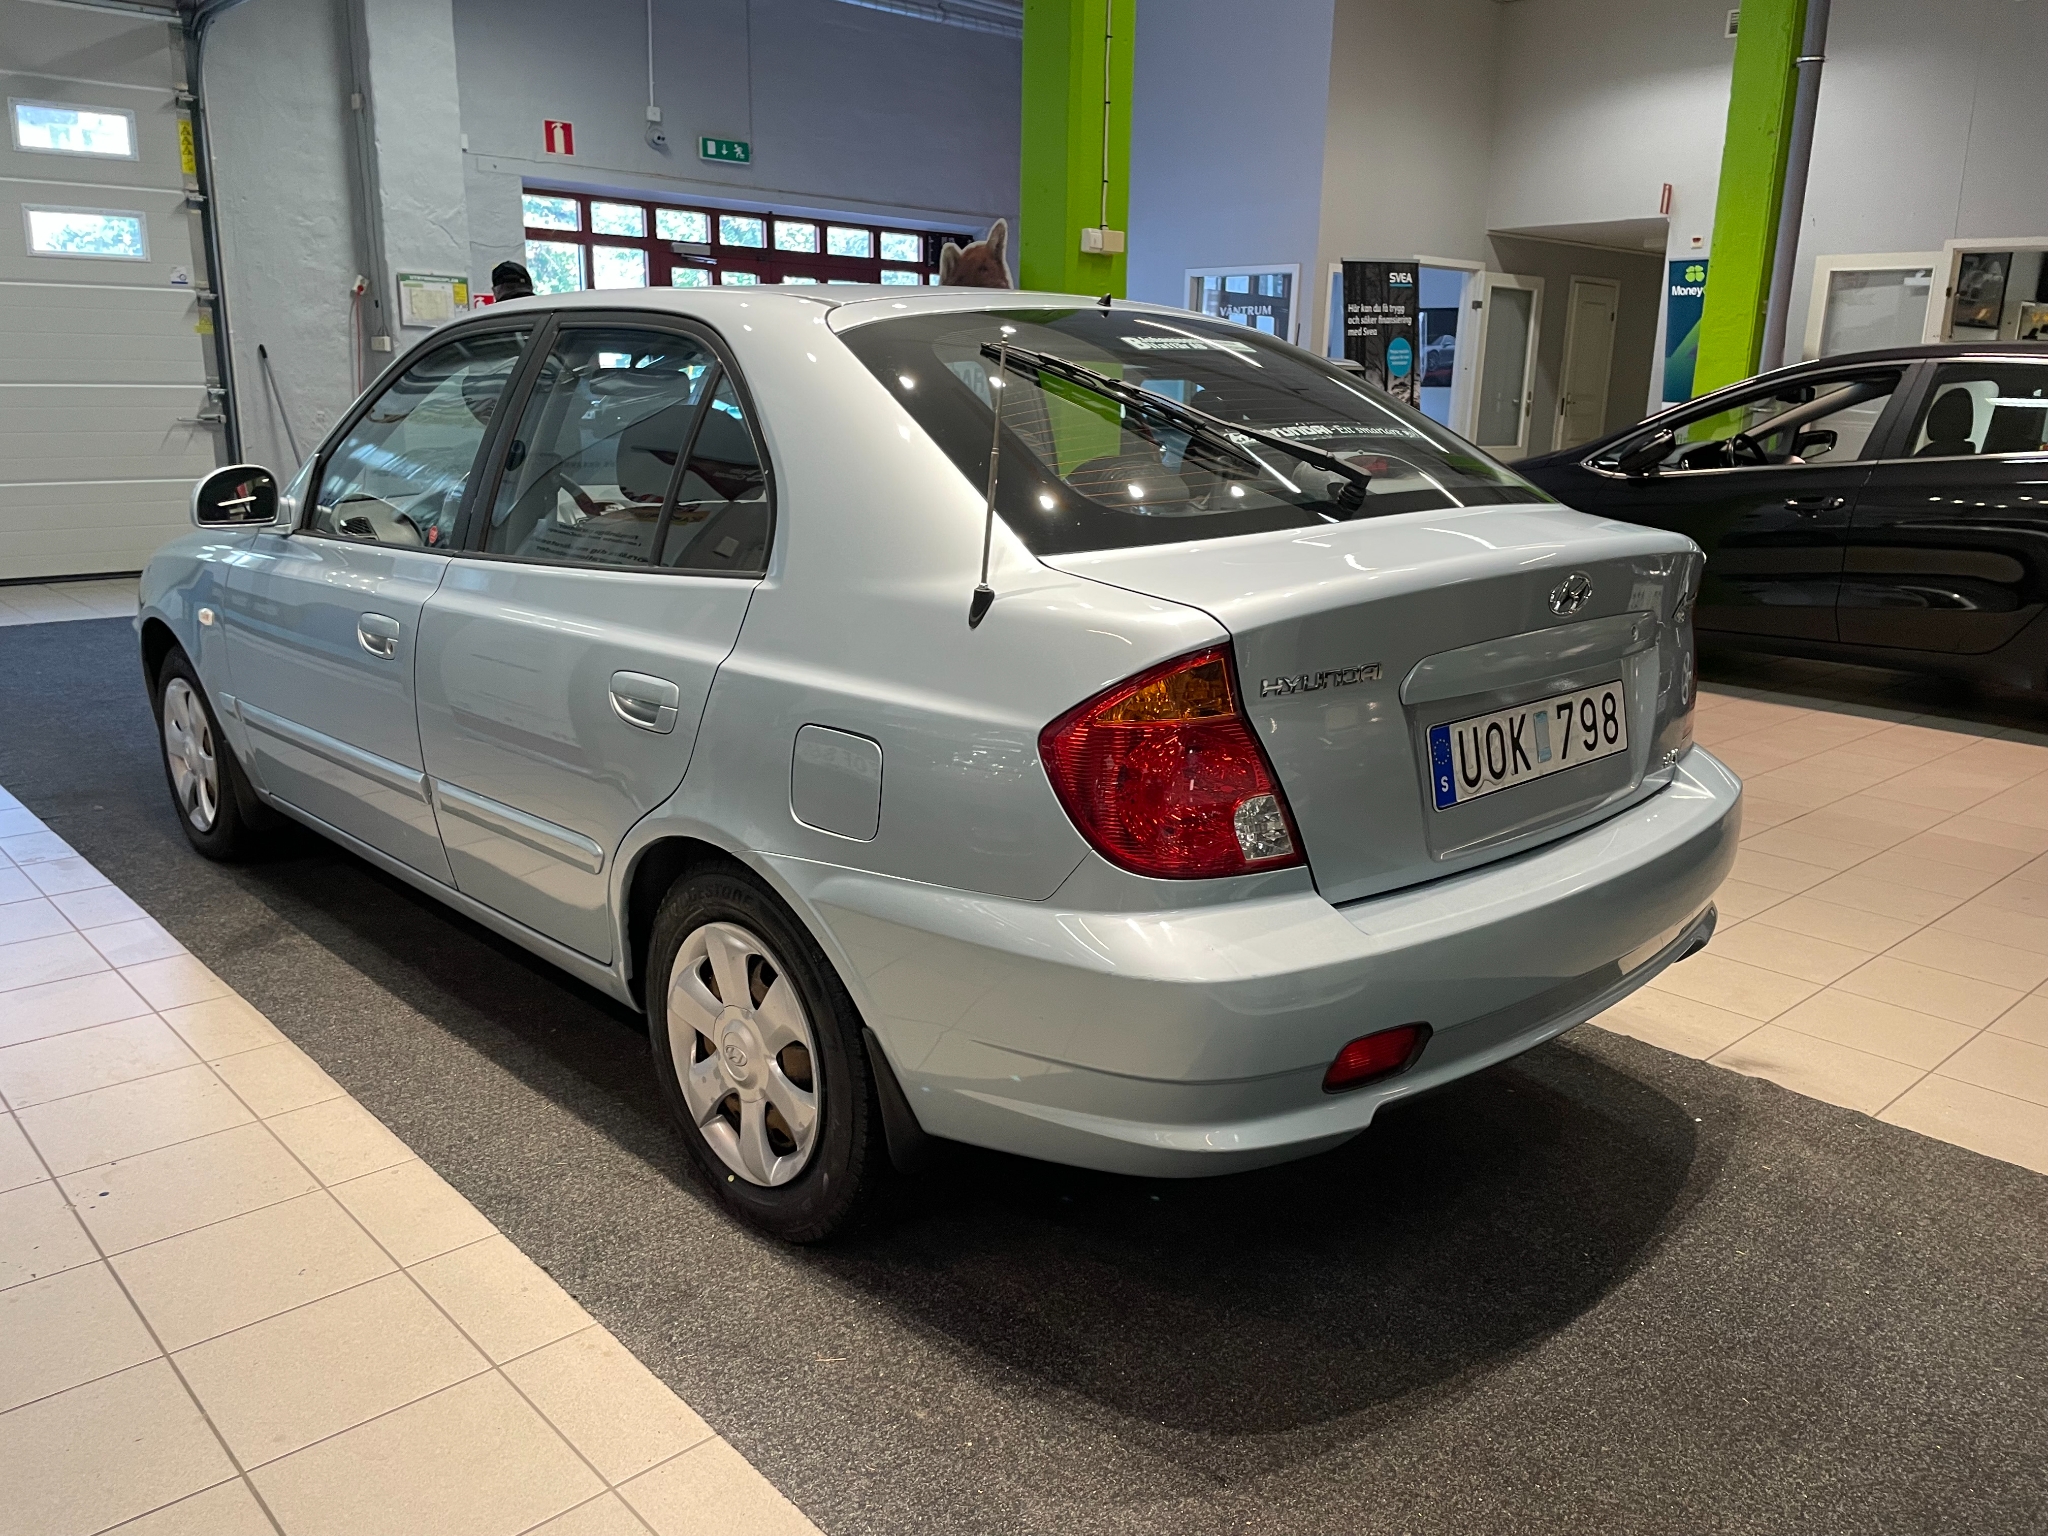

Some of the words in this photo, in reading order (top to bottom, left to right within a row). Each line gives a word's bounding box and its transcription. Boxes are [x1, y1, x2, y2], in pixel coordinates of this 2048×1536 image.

[1389, 272, 1413, 283] SVEA
[1671, 285, 1705, 298] Money
[1347, 303, 1360, 313] Här
[1361, 303, 1372, 313] kan
[1373, 303, 1382, 313] du
[1382, 303, 1389, 313] få
[1389, 304, 1405, 315] trygg
[1347, 315, 1360, 325] och
[1361, 315, 1378, 325] säker
[1378, 315, 1413, 326] finansiering
[1347, 327, 1362, 336] med
[1363, 327, 1378, 336] Svea
[1260, 661, 1383, 698] HYUNDAI
[1458, 713, 1532, 788] UOK
[1556, 691, 1619, 760] 798
[1441, 776, 1449, 793] S
